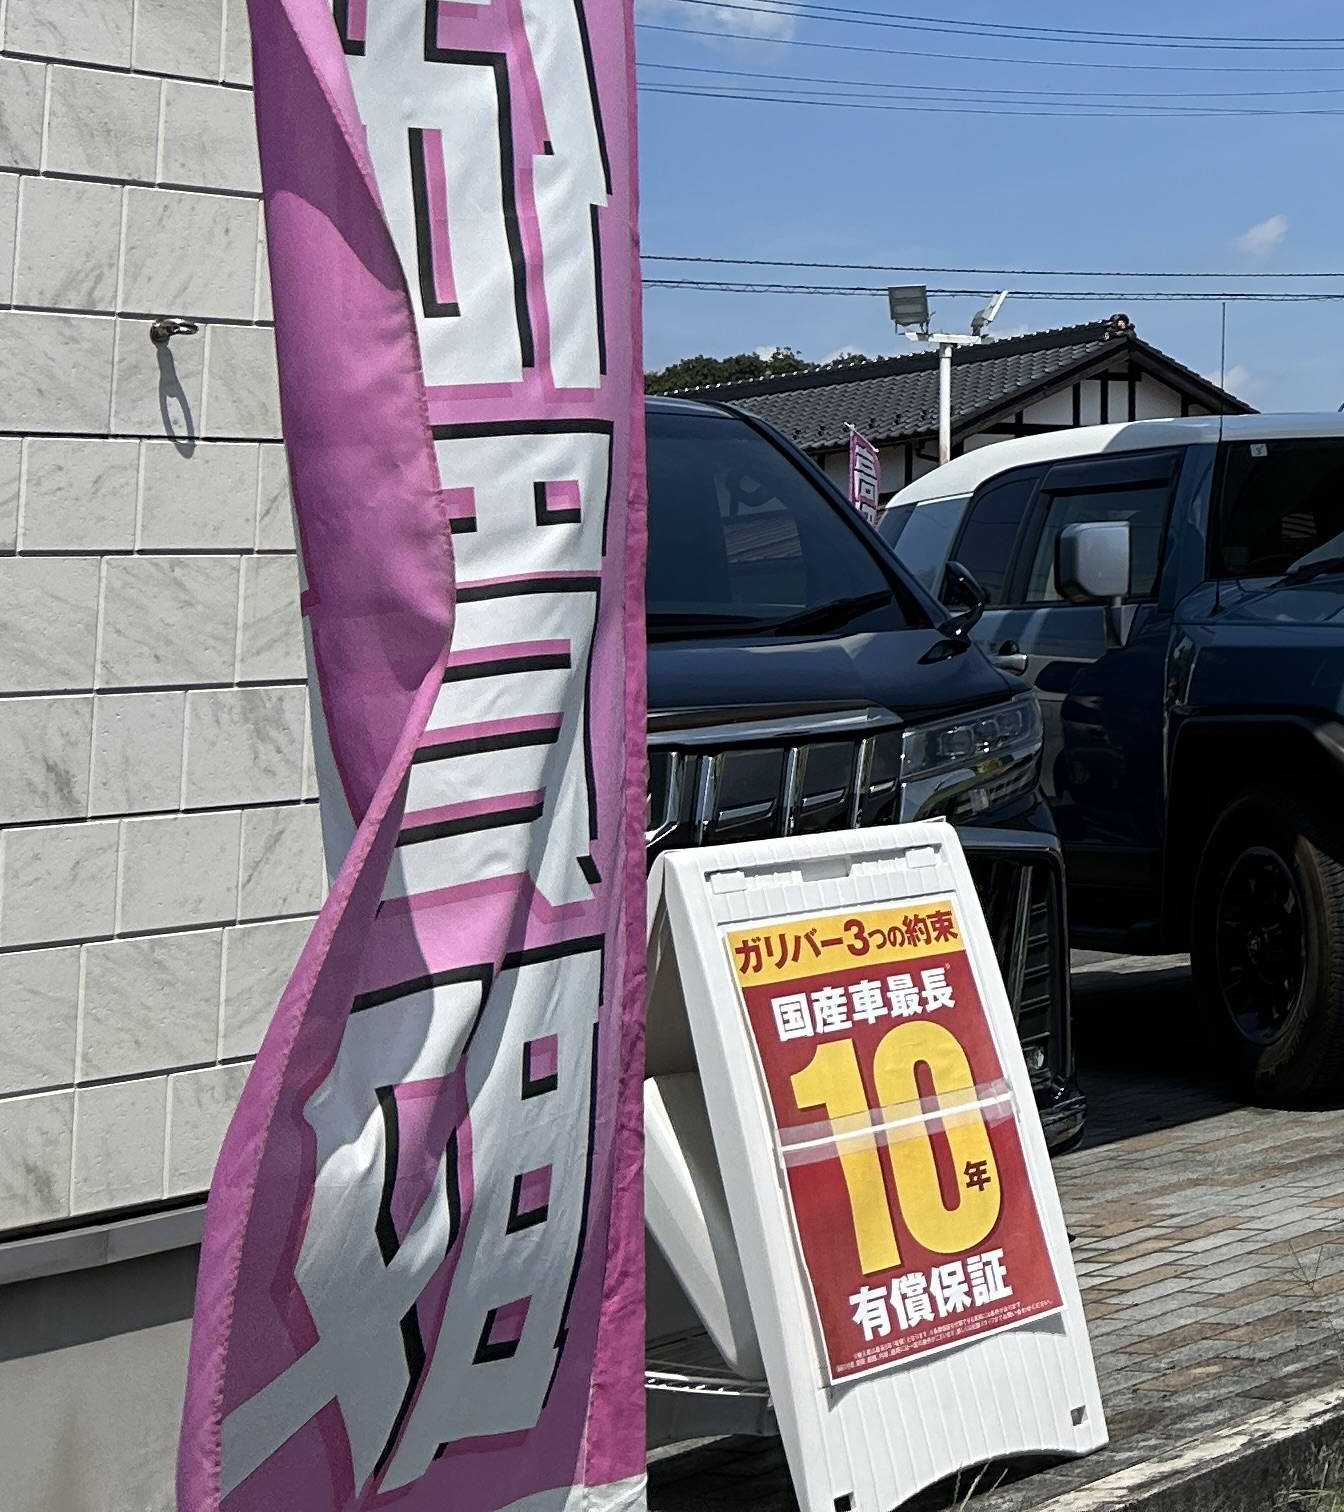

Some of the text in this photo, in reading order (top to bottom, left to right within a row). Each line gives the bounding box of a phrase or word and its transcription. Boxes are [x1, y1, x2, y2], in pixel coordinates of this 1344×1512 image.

[734, 908, 960, 975] ガリバー3つの約束
[769, 966, 956, 1042] 国産車最長
[849, 1249, 1014, 1342] 有償保証
